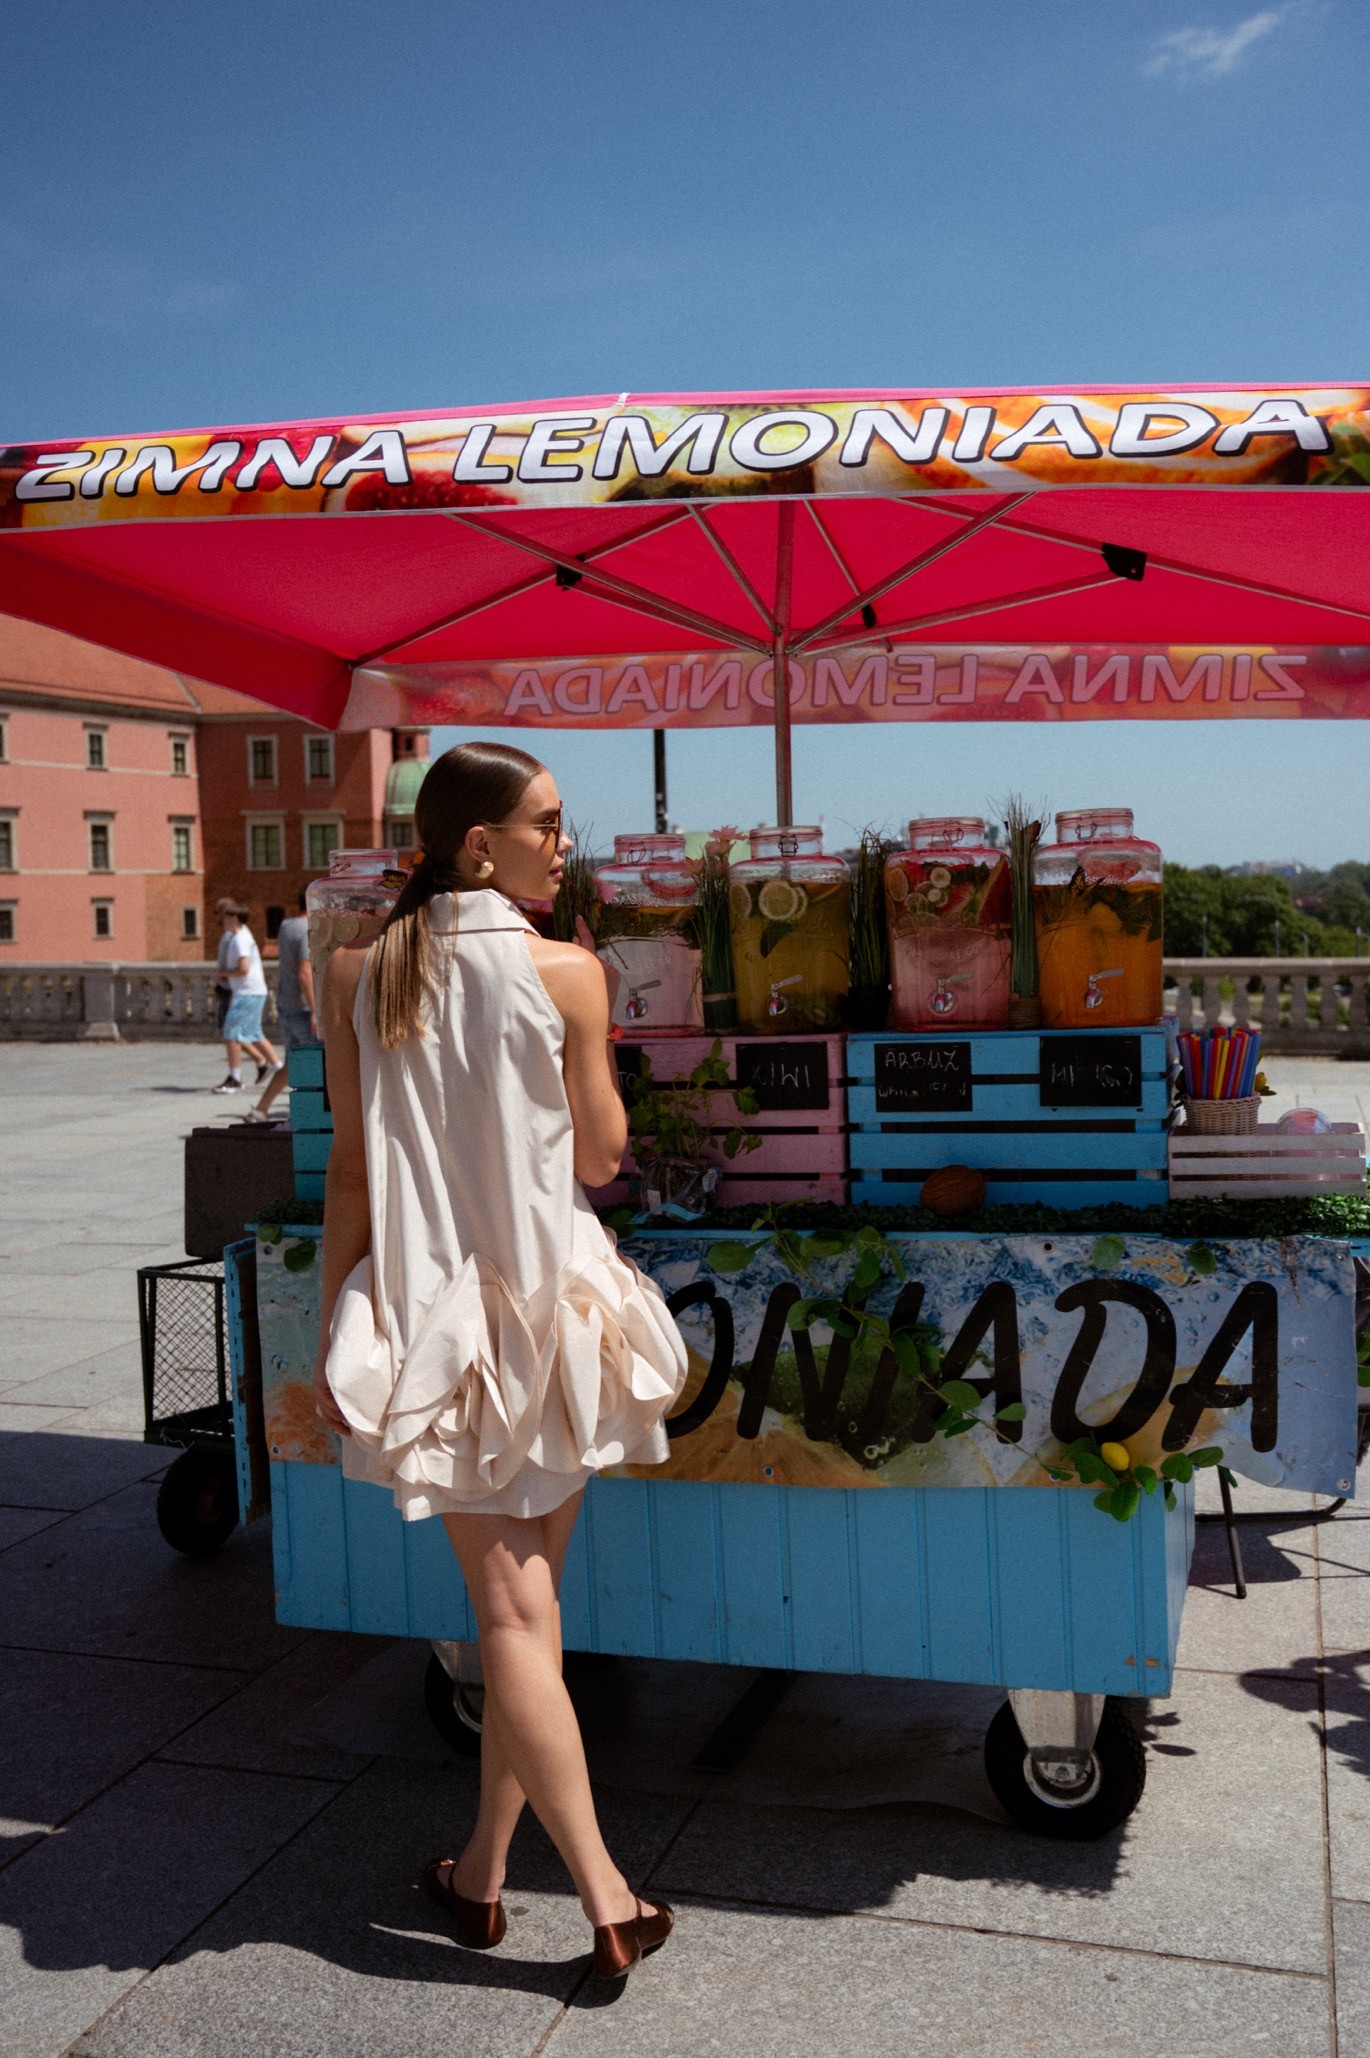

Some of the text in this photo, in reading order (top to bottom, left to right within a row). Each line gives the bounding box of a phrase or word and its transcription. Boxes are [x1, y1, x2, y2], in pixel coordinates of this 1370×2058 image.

[15, 400, 1334, 502] ZIMNA LEMONIADA
[752, 1062, 810, 1088] KIWI
